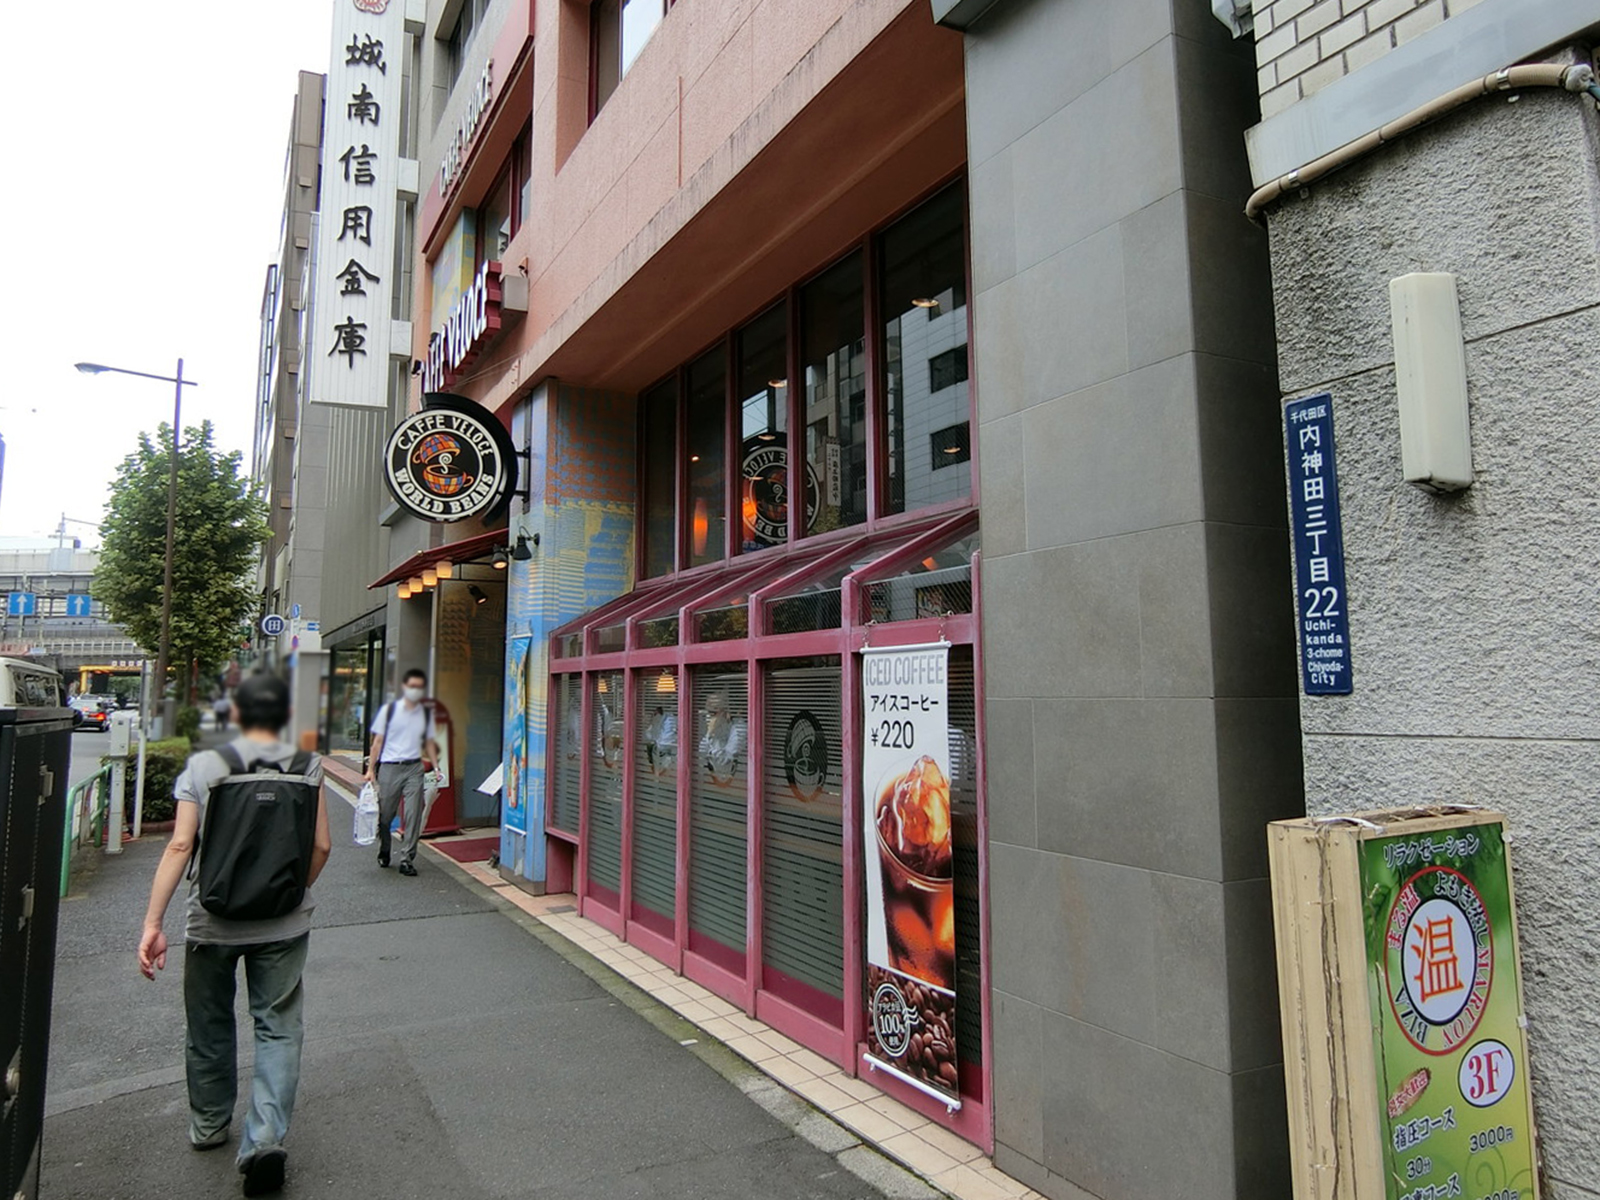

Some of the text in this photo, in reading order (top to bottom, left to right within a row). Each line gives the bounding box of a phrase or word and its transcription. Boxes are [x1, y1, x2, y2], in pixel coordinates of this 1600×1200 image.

[328, 33, 387, 370] 城南信用金庫
[447, 259, 490, 374] VELOCE
[1290, 404, 1327, 424] 千代田区
[397, 415, 494, 456] CAFFE VELOCE
[394, 467, 494, 513] WORLD BEANS
[1299, 424, 1329, 583] 内神田三丁目
[1304, 586, 1339, 618] 22
[1304, 620, 1336, 631] Uchi-
[1305, 633, 1343, 645] kanda
[1306, 648, 1343, 659] 3-chome
[1307, 661, 1344, 675] Chiyoda-
[865, 654, 944, 687] ICED COFFEE
[1311, 672, 1336, 686] City
[870, 694, 939, 712] アイスコーヒー
[871, 720, 914, 749] ¥220
[1383, 834, 1480, 868] リラクゼーション
[1387, 882, 1421, 951] まる温
[1434, 870, 1490, 949] よもぎ蒸し
[1411, 914, 1465, 1004] 温
[1442, 948, 1490, 1047] MARUON
[1468, 1050, 1503, 1100] 3F
[1393, 1106, 1458, 1152] 指圧コース
[1469, 1126, 1513, 1152] 3000円
[1406, 1157, 1431, 1179] 30分
